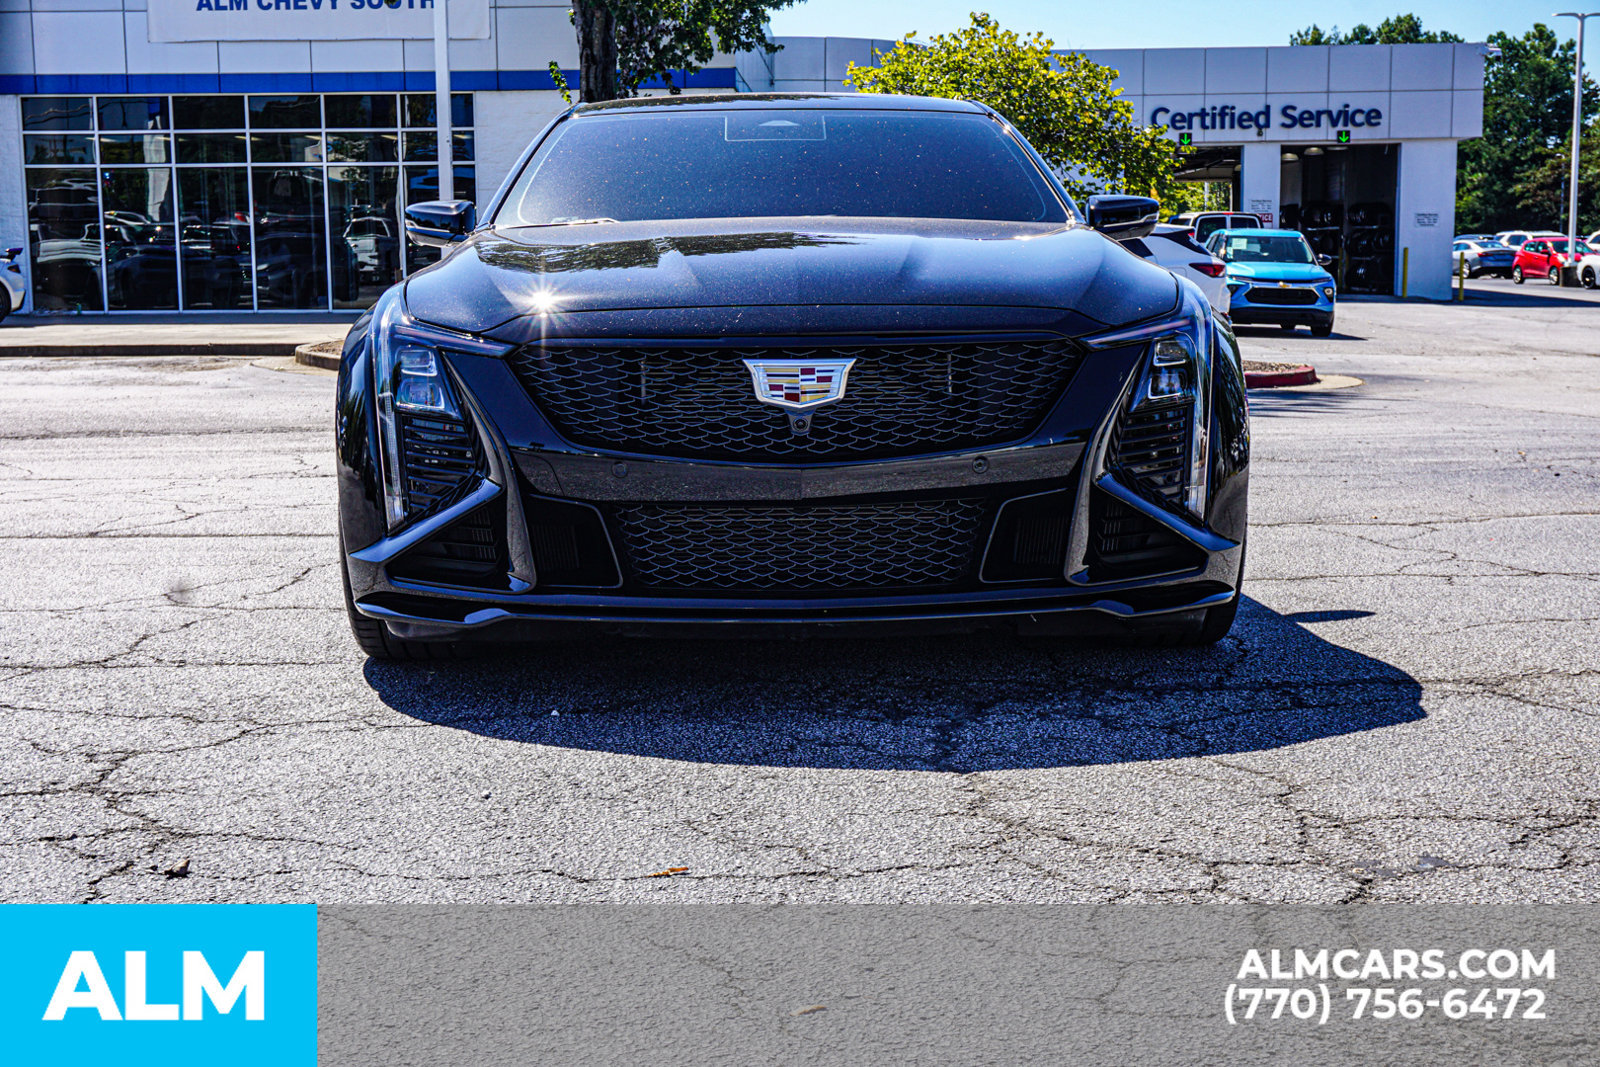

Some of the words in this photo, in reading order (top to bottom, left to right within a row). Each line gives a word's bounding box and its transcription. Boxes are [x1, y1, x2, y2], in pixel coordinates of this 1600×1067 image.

[196, 0, 248, 11] ALM
[257, 0, 338, 10] CHEVY
[1150, 104, 1271, 131] Certified
[1280, 104, 1383, 129] Service
